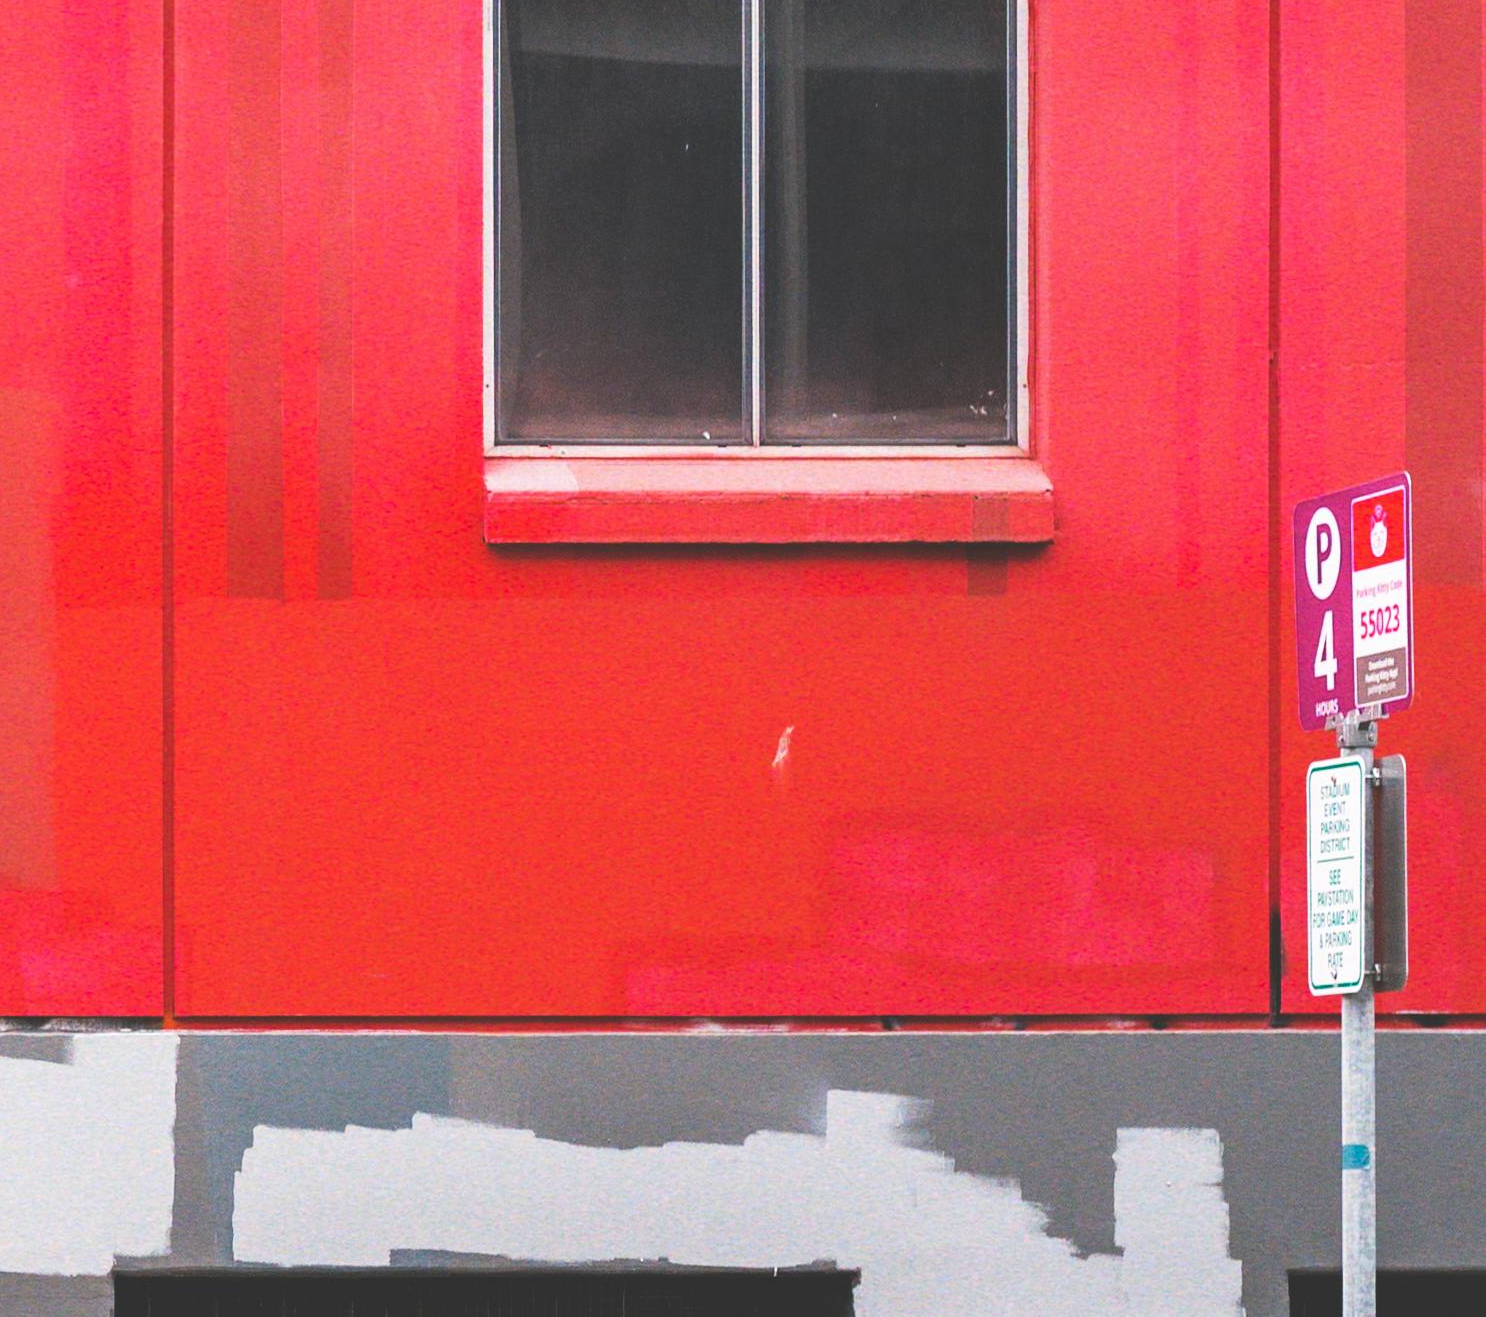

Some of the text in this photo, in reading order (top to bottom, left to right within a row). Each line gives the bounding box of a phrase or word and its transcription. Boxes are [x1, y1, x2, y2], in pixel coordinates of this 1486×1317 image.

[1316, 523, 1333, 585] P
[1360, 604, 1400, 639] 55023
[1313, 610, 1338, 691] 4
[1315, 698, 1339, 718] HOURS
[1320, 783, 1351, 800] STADIUM
[1324, 801, 1346, 817] EVENT
[1320, 818, 1351, 835] PARKING
[1320, 837, 1351, 854] DISTRICT
[1329, 869, 1341, 885] SEE
[1317, 889, 1354, 906] PAYSTATION
[1313, 909, 1359, 928] FOR GAME DAY
[1325, 930, 1352, 948] PARKING
[1327, 952, 1344, 970] RATE
